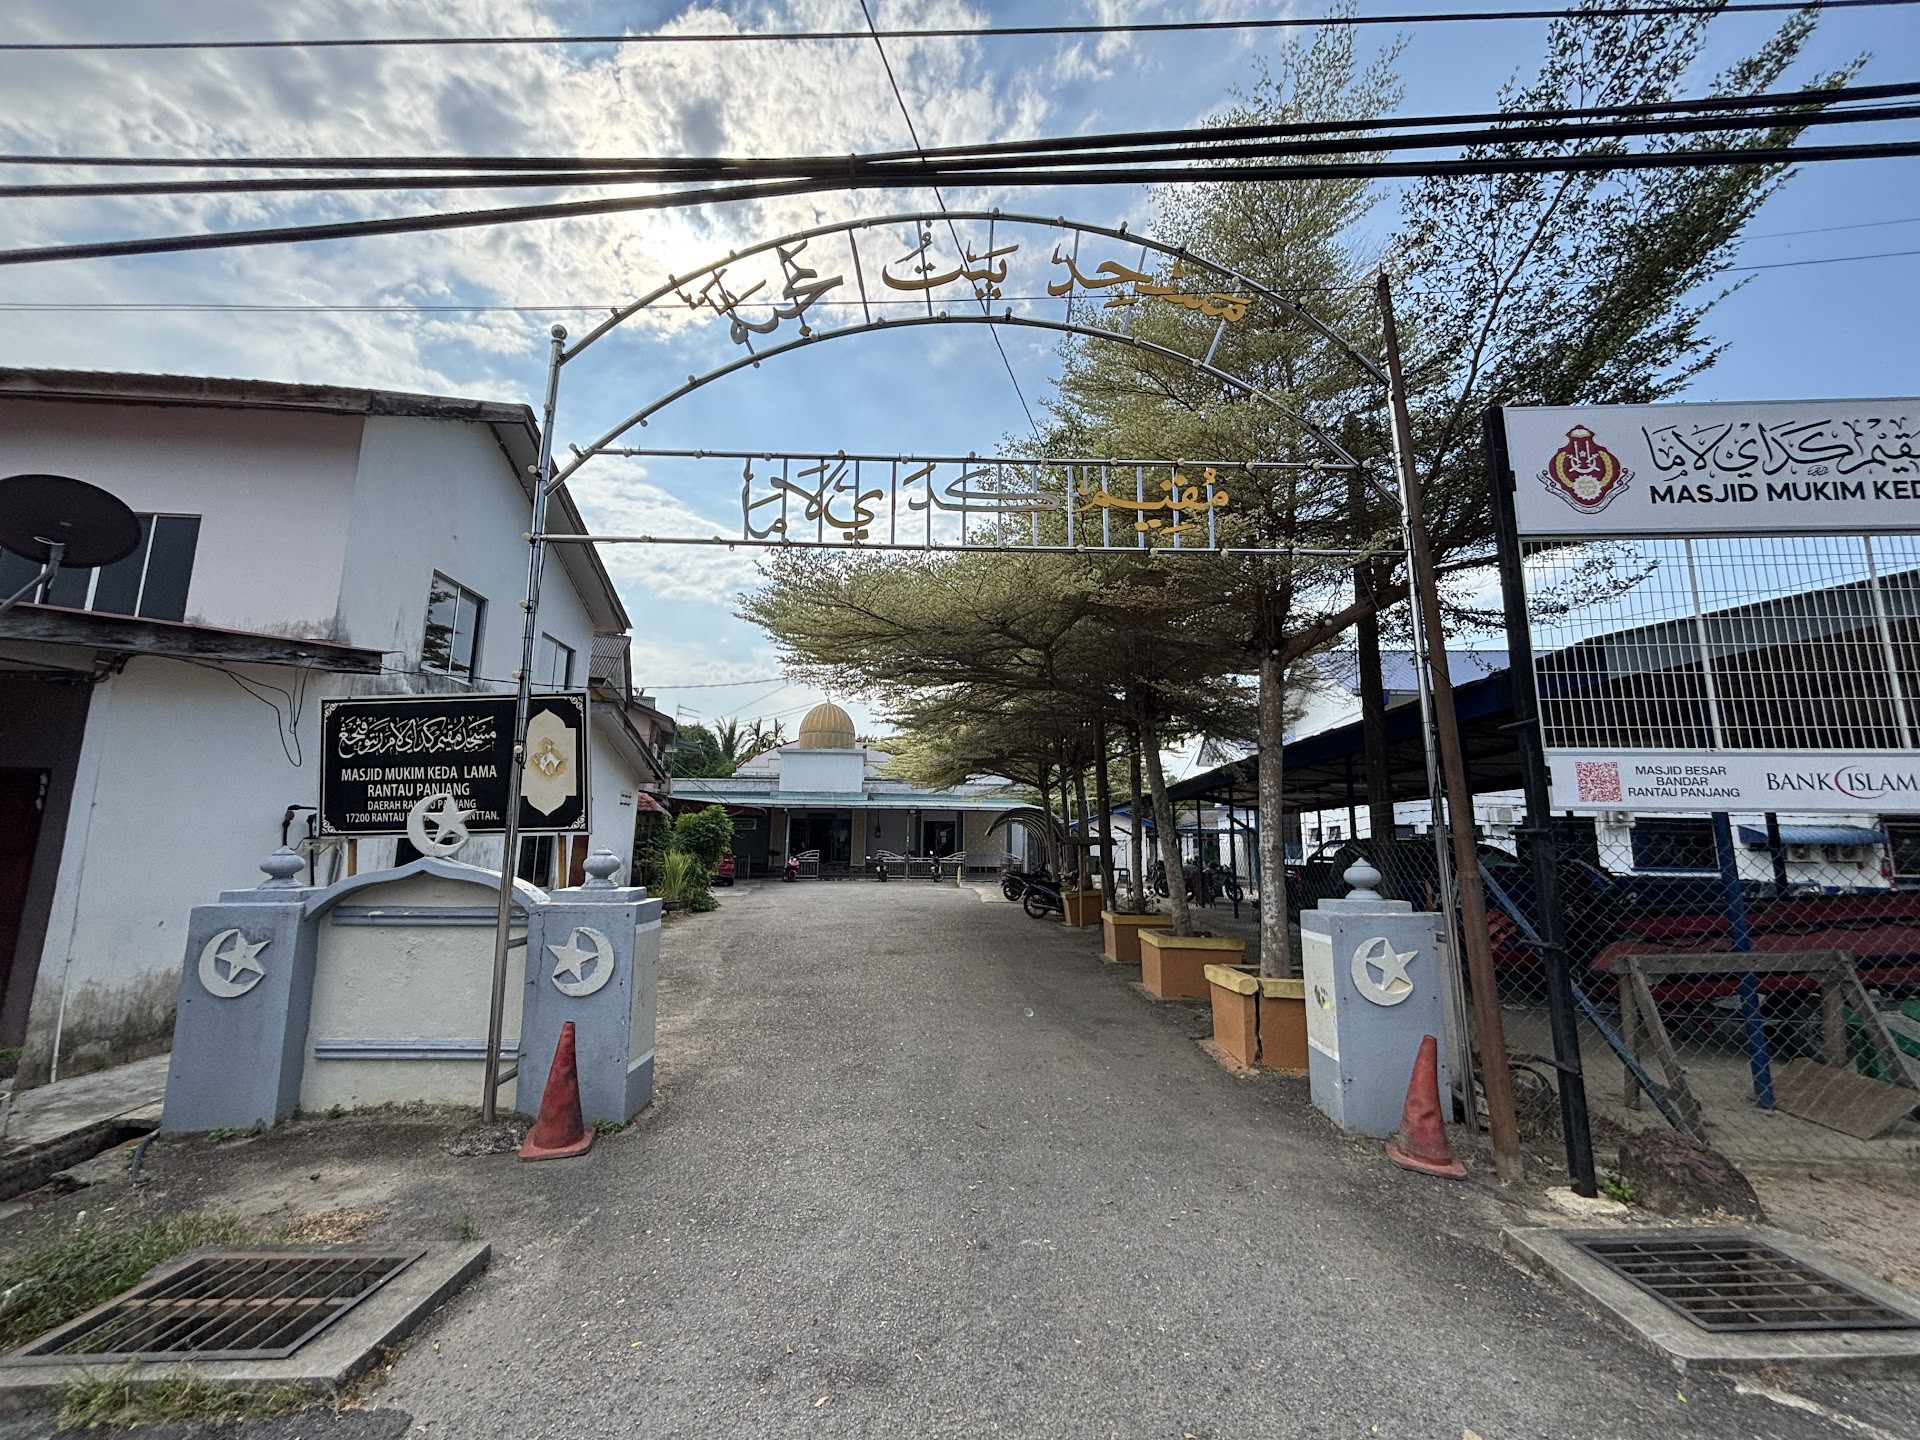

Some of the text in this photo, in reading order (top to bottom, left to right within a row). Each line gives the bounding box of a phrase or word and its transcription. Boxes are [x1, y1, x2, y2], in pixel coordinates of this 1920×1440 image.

[1650, 482, 1758, 504] MASJID
[1766, 481, 1866, 502] MUKIM
[341, 765, 497, 781] MASJID MUKIM KEDA LAMA
[1635, 766, 1726, 775] MASJID BESAR
[1657, 777, 1709, 786] BANDAR
[1766, 772, 1919, 792] BANK ISLAM
[367, 782, 470, 797] RANTAU PANJANG
[1628, 788, 1740, 798] RANTAU PANJANG
[368, 800, 401, 811] DAERAH
[346, 813, 370, 823] 17200
[372, 812, 405, 822] RANTAU
